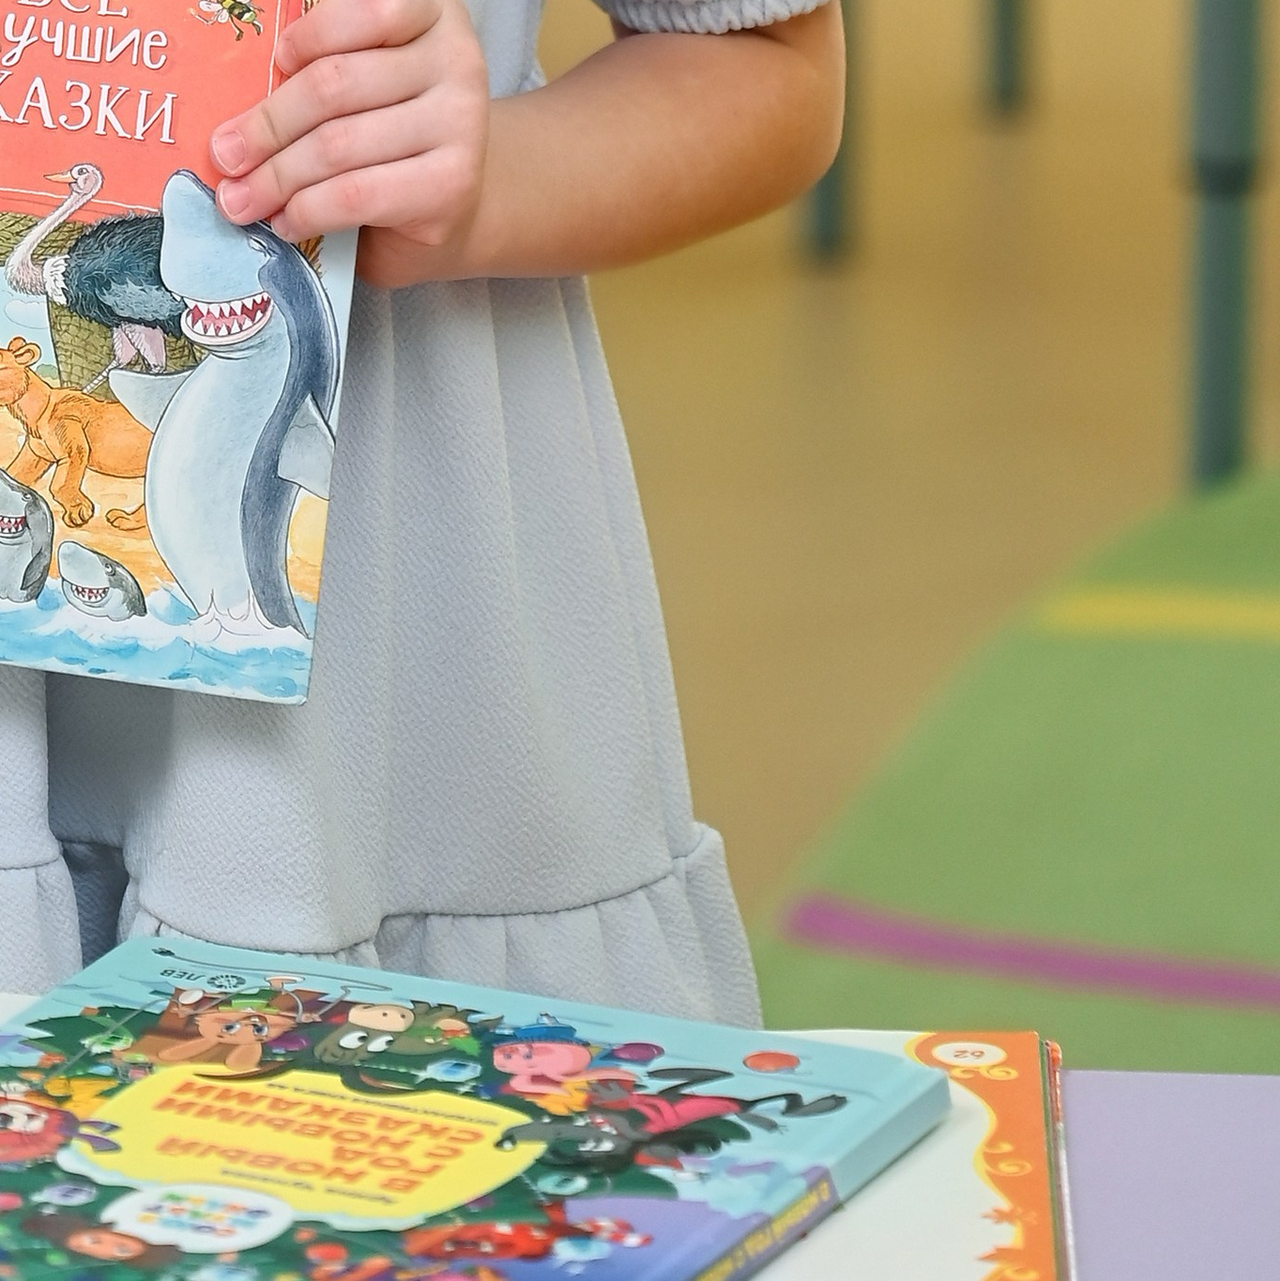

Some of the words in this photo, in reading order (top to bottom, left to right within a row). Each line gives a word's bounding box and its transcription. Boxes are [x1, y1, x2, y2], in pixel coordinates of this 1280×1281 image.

[159, 969, 206, 982] ЛЕВ
[953, 1049, 985, 1061] 62
[152, 1098, 413, 1152] НОВЫМИ
[172, 1082, 485, 1145] СКАЗКАМИ
[155, 1138, 367, 1188] НОВЫЙ
[332, 1146, 443, 1178] ГОД
[425, 1145, 463, 1160] С
[379, 1178, 421, 1194] В
